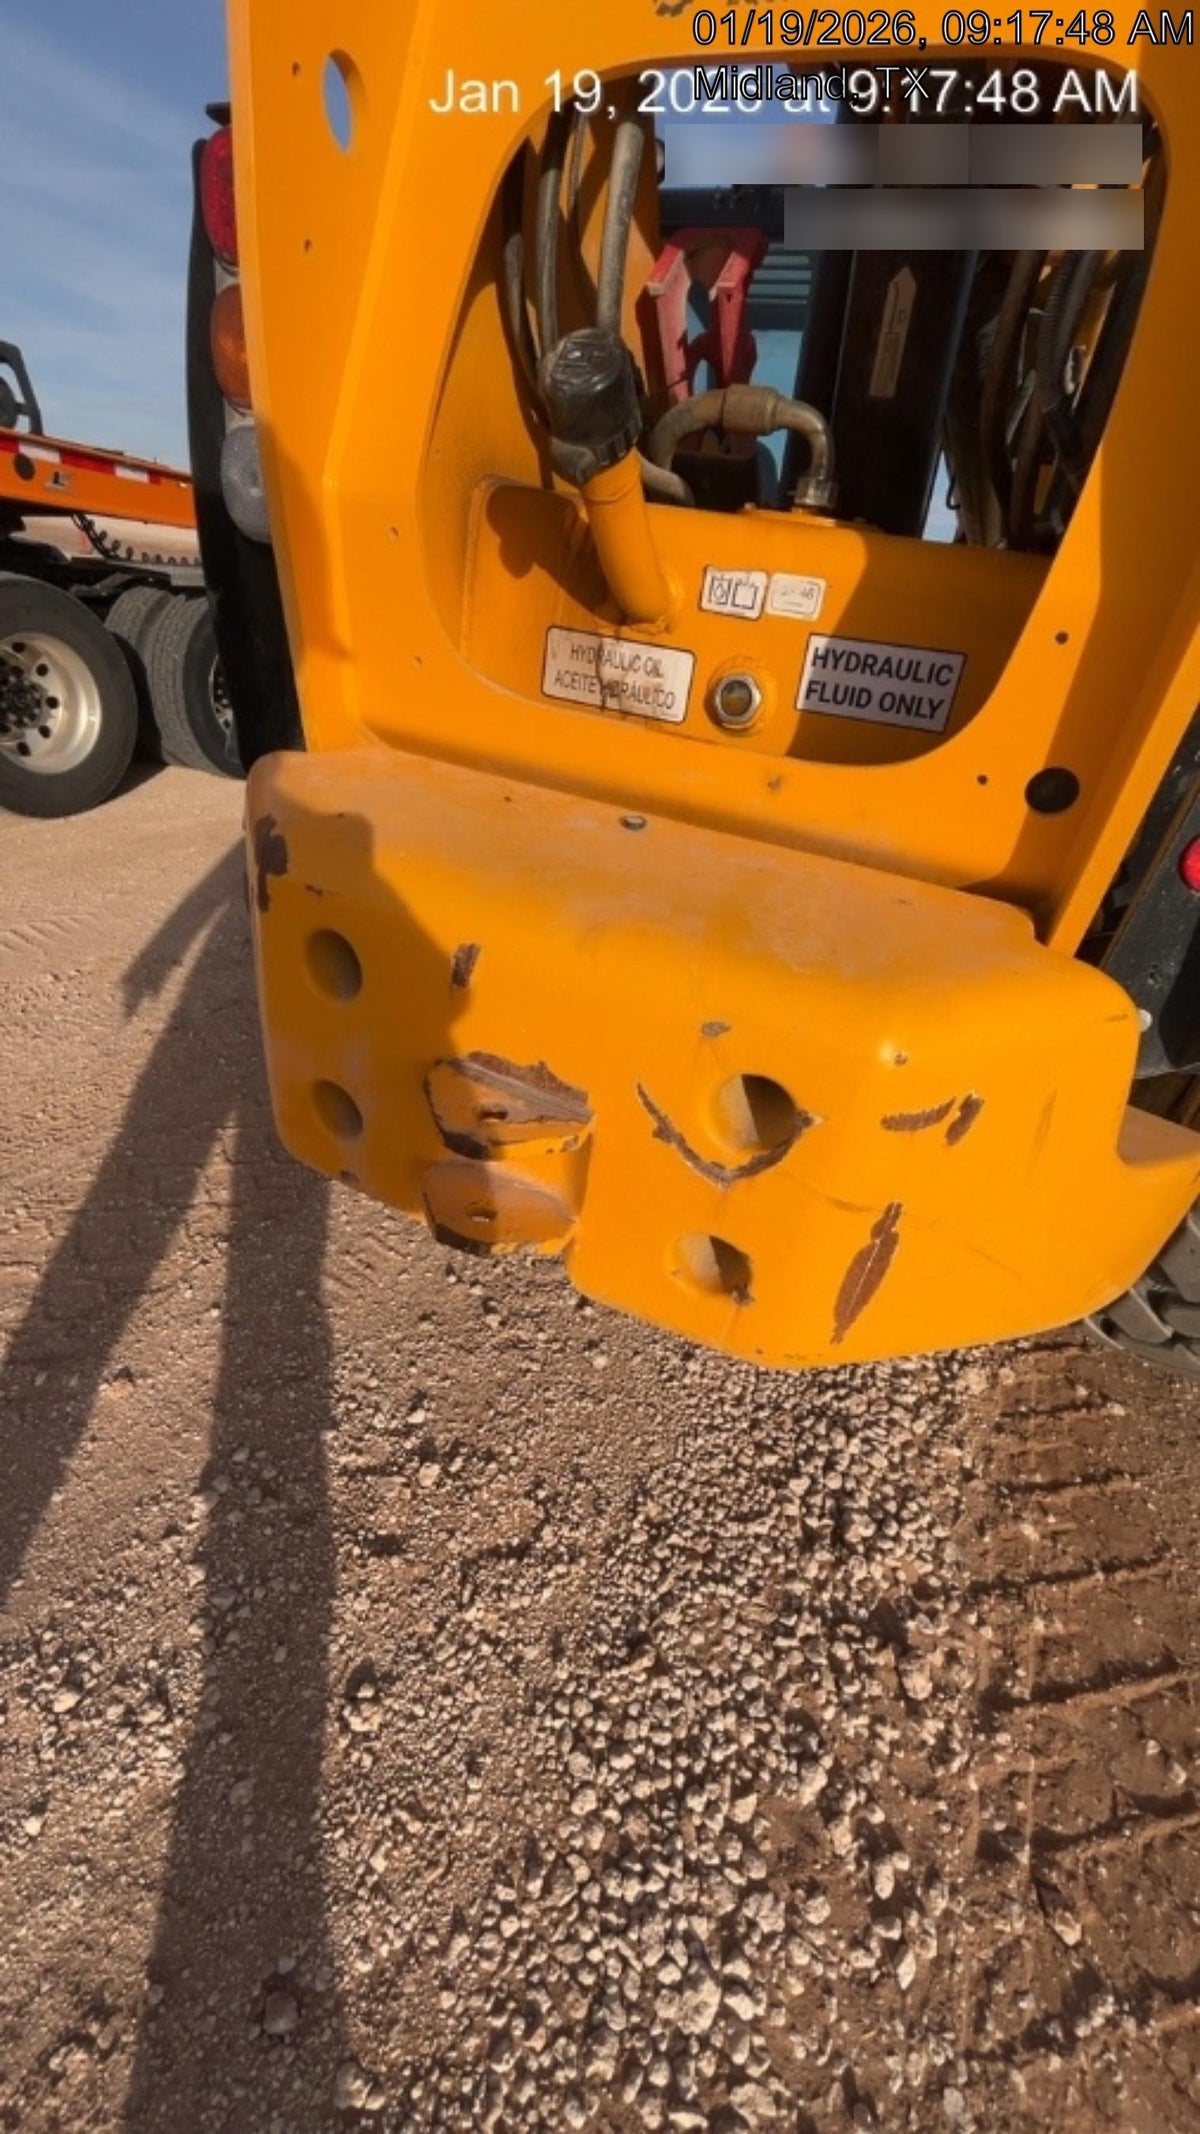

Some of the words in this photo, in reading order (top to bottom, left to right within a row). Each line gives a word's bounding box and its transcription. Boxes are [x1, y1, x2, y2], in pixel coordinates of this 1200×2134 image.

[570, 643, 641, 674] HYDRAULIC
[643, 656, 665, 680] OIL
[811, 646, 954, 687] HYDRAULIC
[553, 668, 598, 695] ACEITE
[806, 680, 873, 709] FLUID
[879, 691, 945, 720] ONLY
